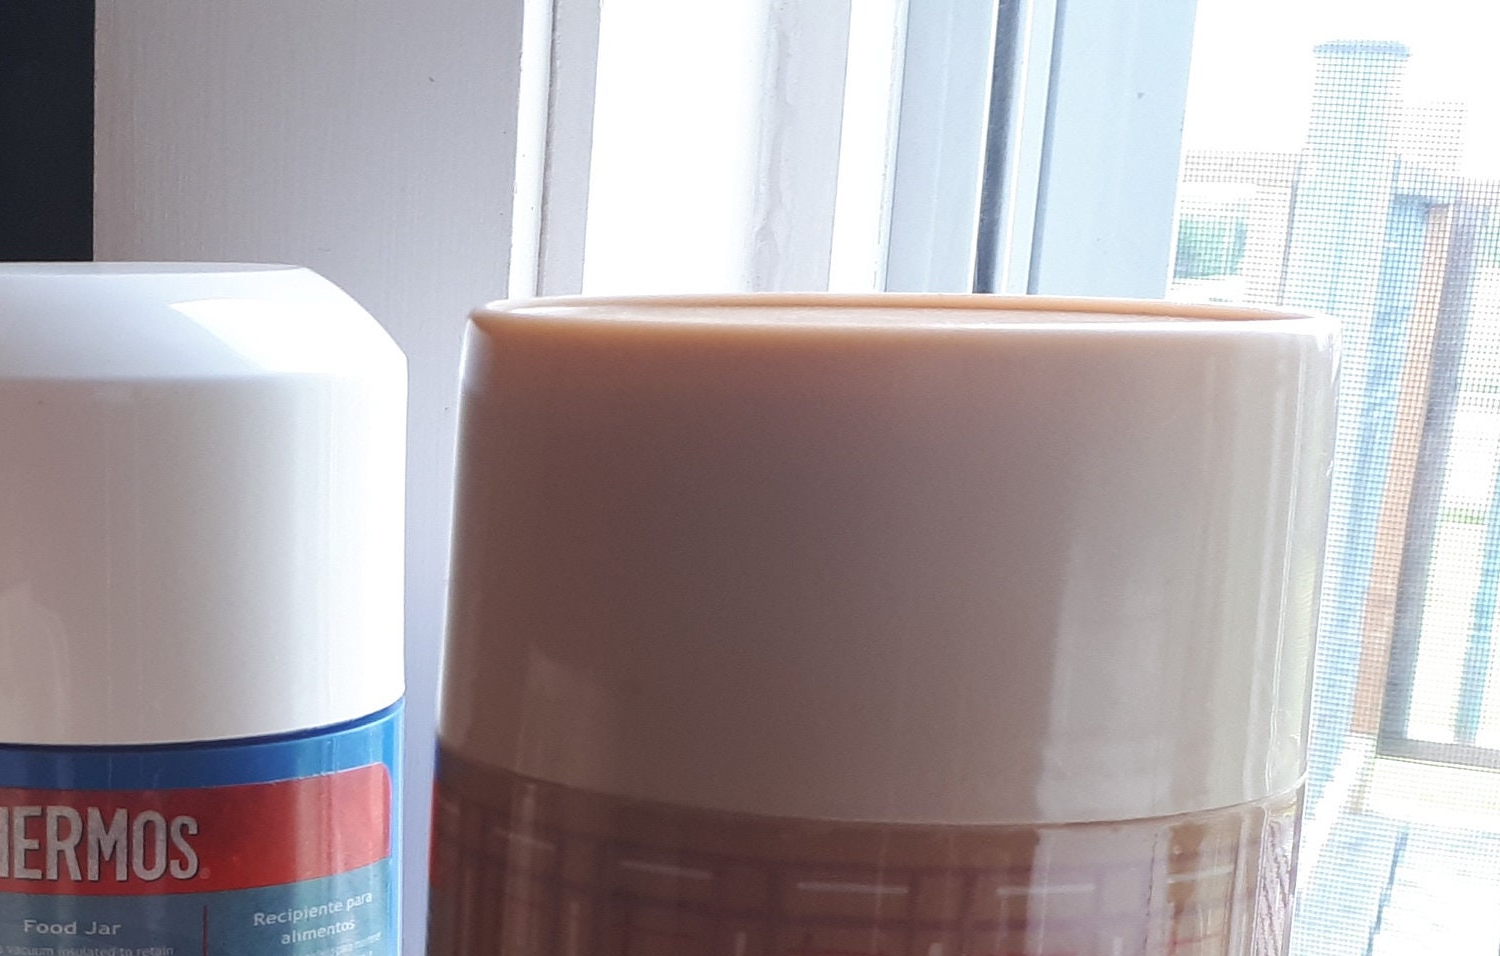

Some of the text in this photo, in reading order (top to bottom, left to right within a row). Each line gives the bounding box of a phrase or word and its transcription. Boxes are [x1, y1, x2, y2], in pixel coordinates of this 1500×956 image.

[251, 892, 373, 927] Recipiente para
[23, 919, 122, 936] Food Jar
[281, 919, 357, 945] alimentos
[7, 946, 54, 956] vacuum
[57, 945, 116, 956] insulated
[120, 946, 132, 956] to
[136, 945, 174, 956] retain
